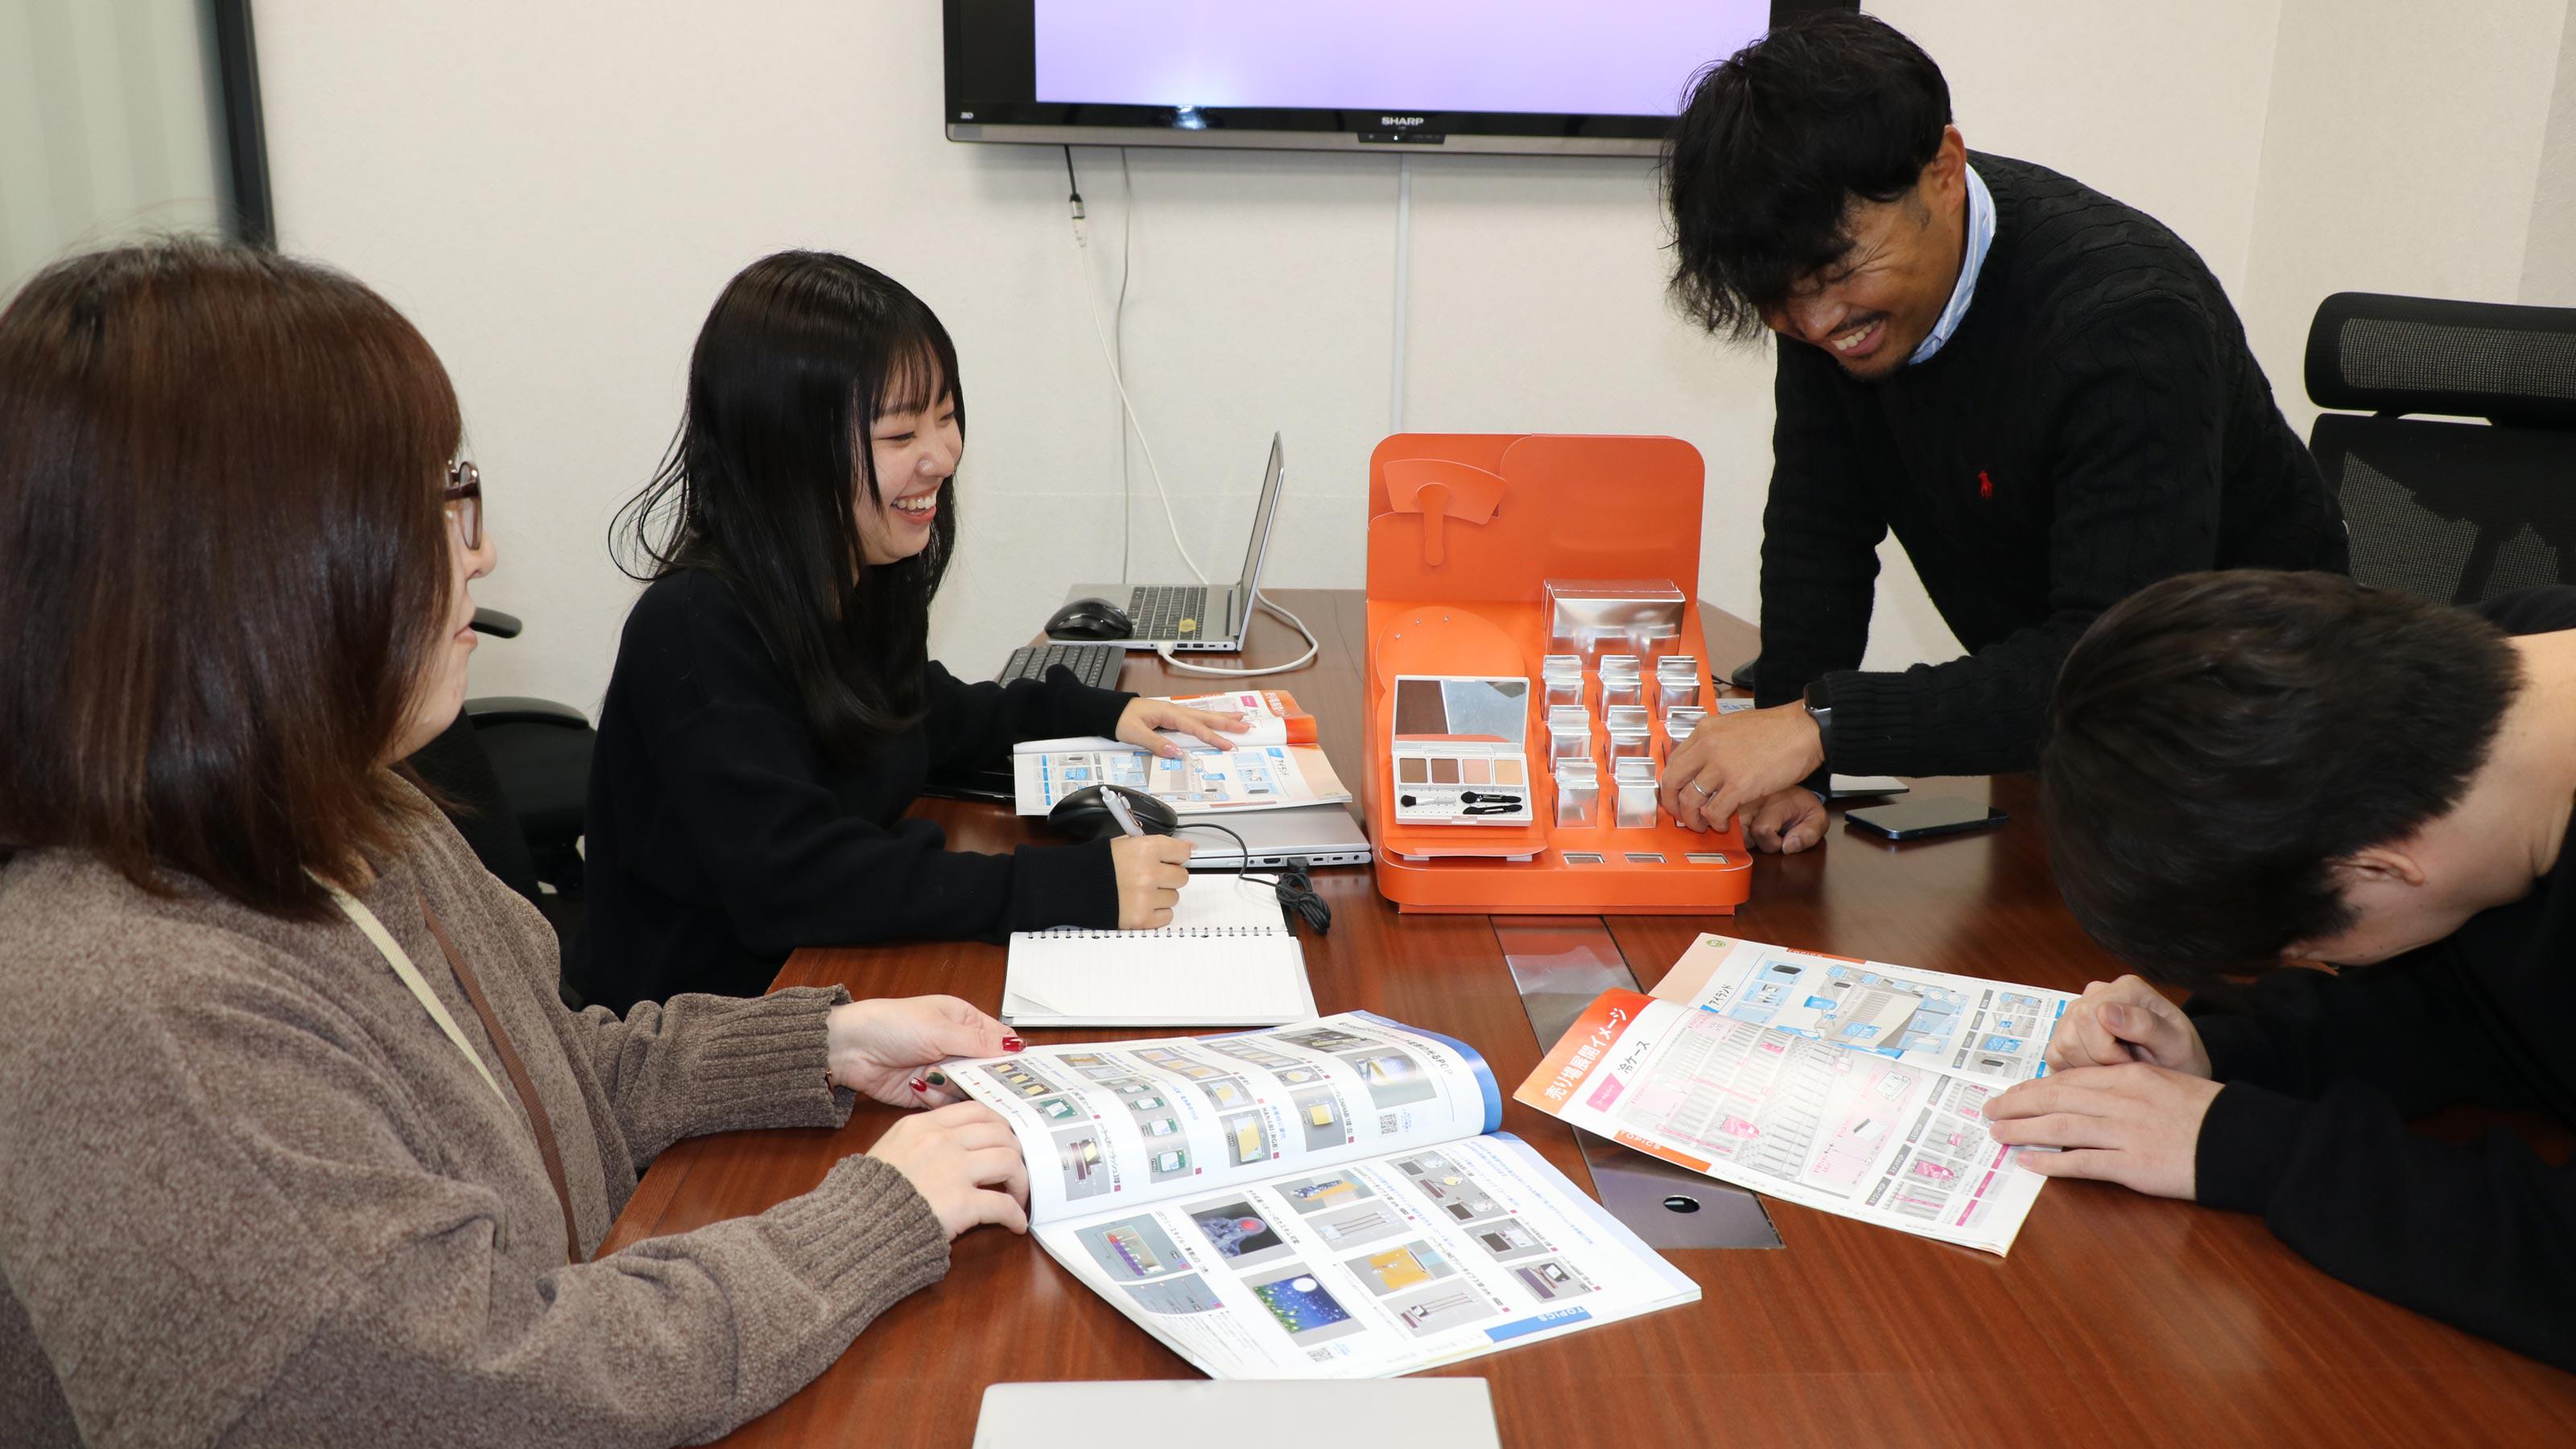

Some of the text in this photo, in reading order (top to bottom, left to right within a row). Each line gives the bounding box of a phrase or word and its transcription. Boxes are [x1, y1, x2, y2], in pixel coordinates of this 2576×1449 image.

[1381, 117, 1424, 126] SHARP
[1545, 1007, 1627, 1101] 売り場展開イメージ
[1616, 1040, 1650, 1074] 冷ケース
[1618, 1129, 1662, 1150] TOPICS
[1538, 1306, 1585, 1323] TOPICS
